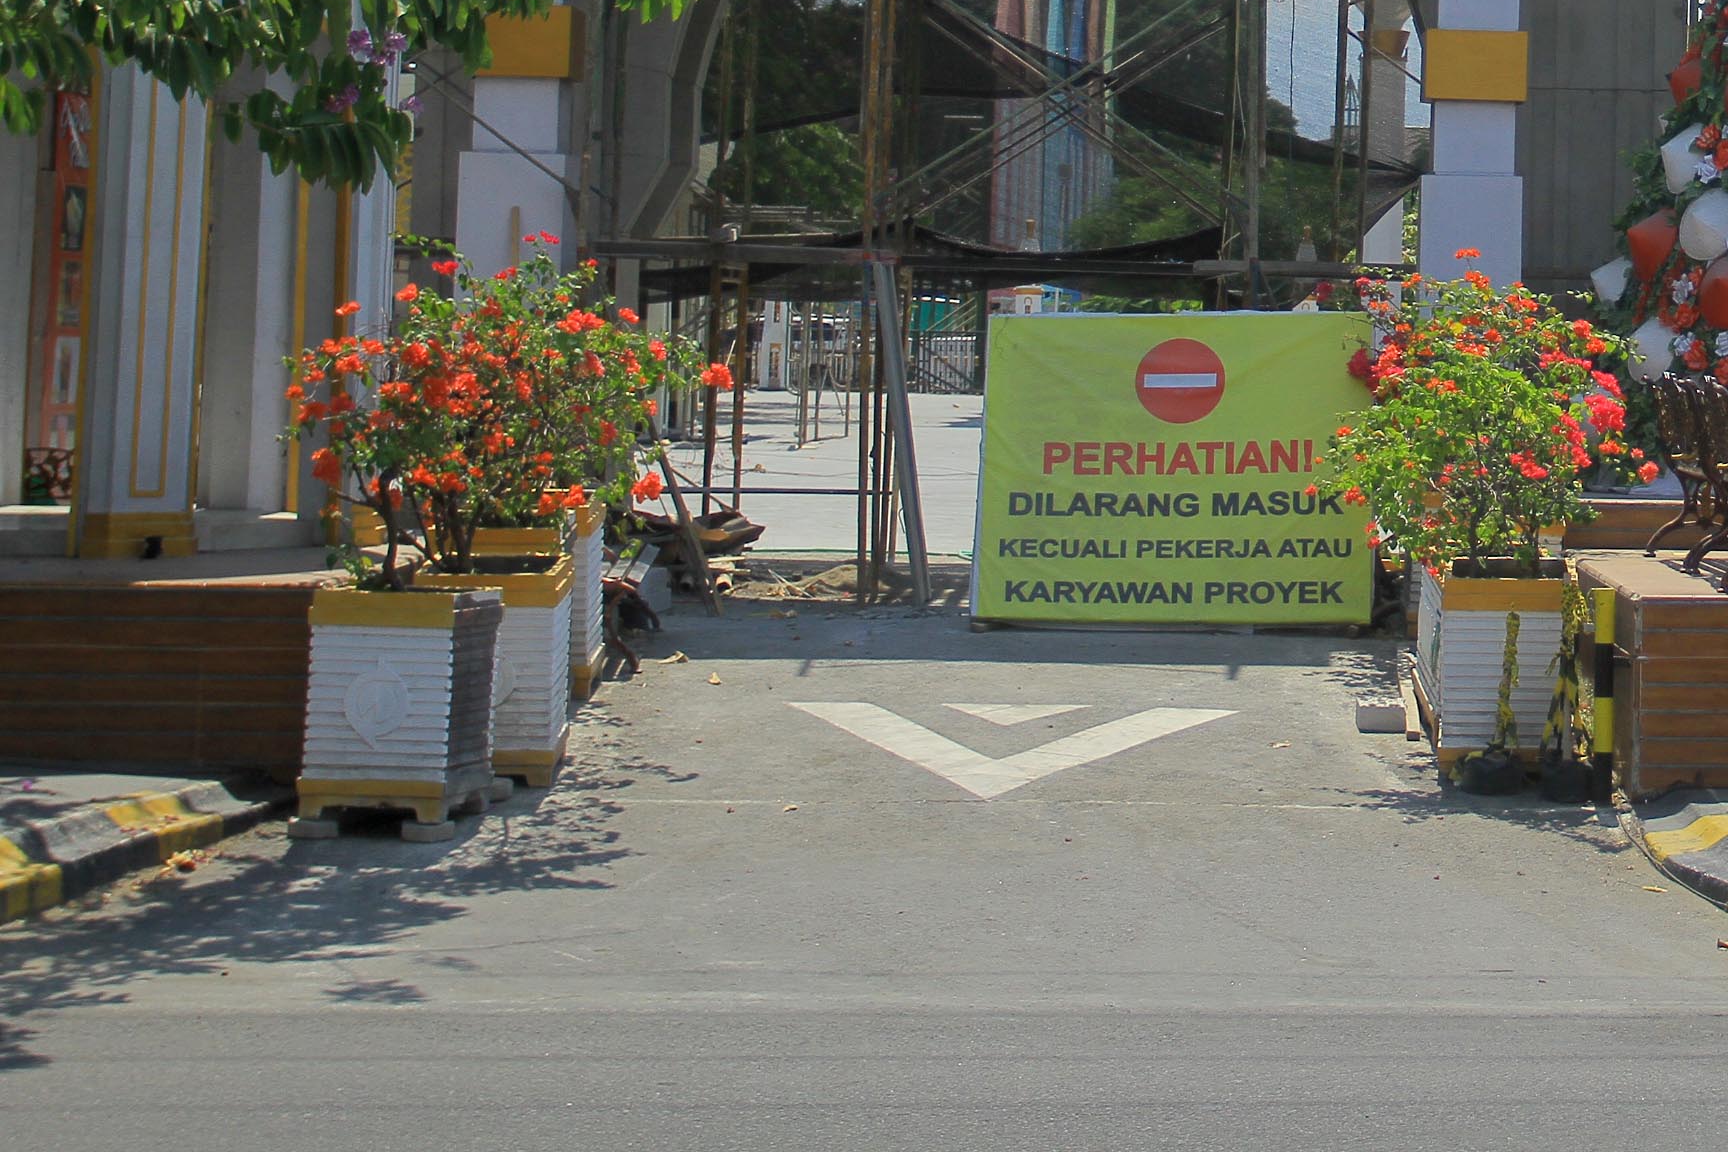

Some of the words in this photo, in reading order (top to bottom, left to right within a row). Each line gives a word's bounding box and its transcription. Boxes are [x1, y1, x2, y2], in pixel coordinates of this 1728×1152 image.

[1043, 439, 1313, 476] PERHATIAN!
[1008, 491, 1200, 517] DILARANG
[1211, 490, 1344, 517] MASUK
[999, 538, 1127, 559] KECUALI
[1136, 538, 1272, 559] PEKERJA
[1276, 538, 1353, 558] ATAU
[1004, 580, 1193, 604] KARYAWAN
[1204, 580, 1344, 604] PROYEK
